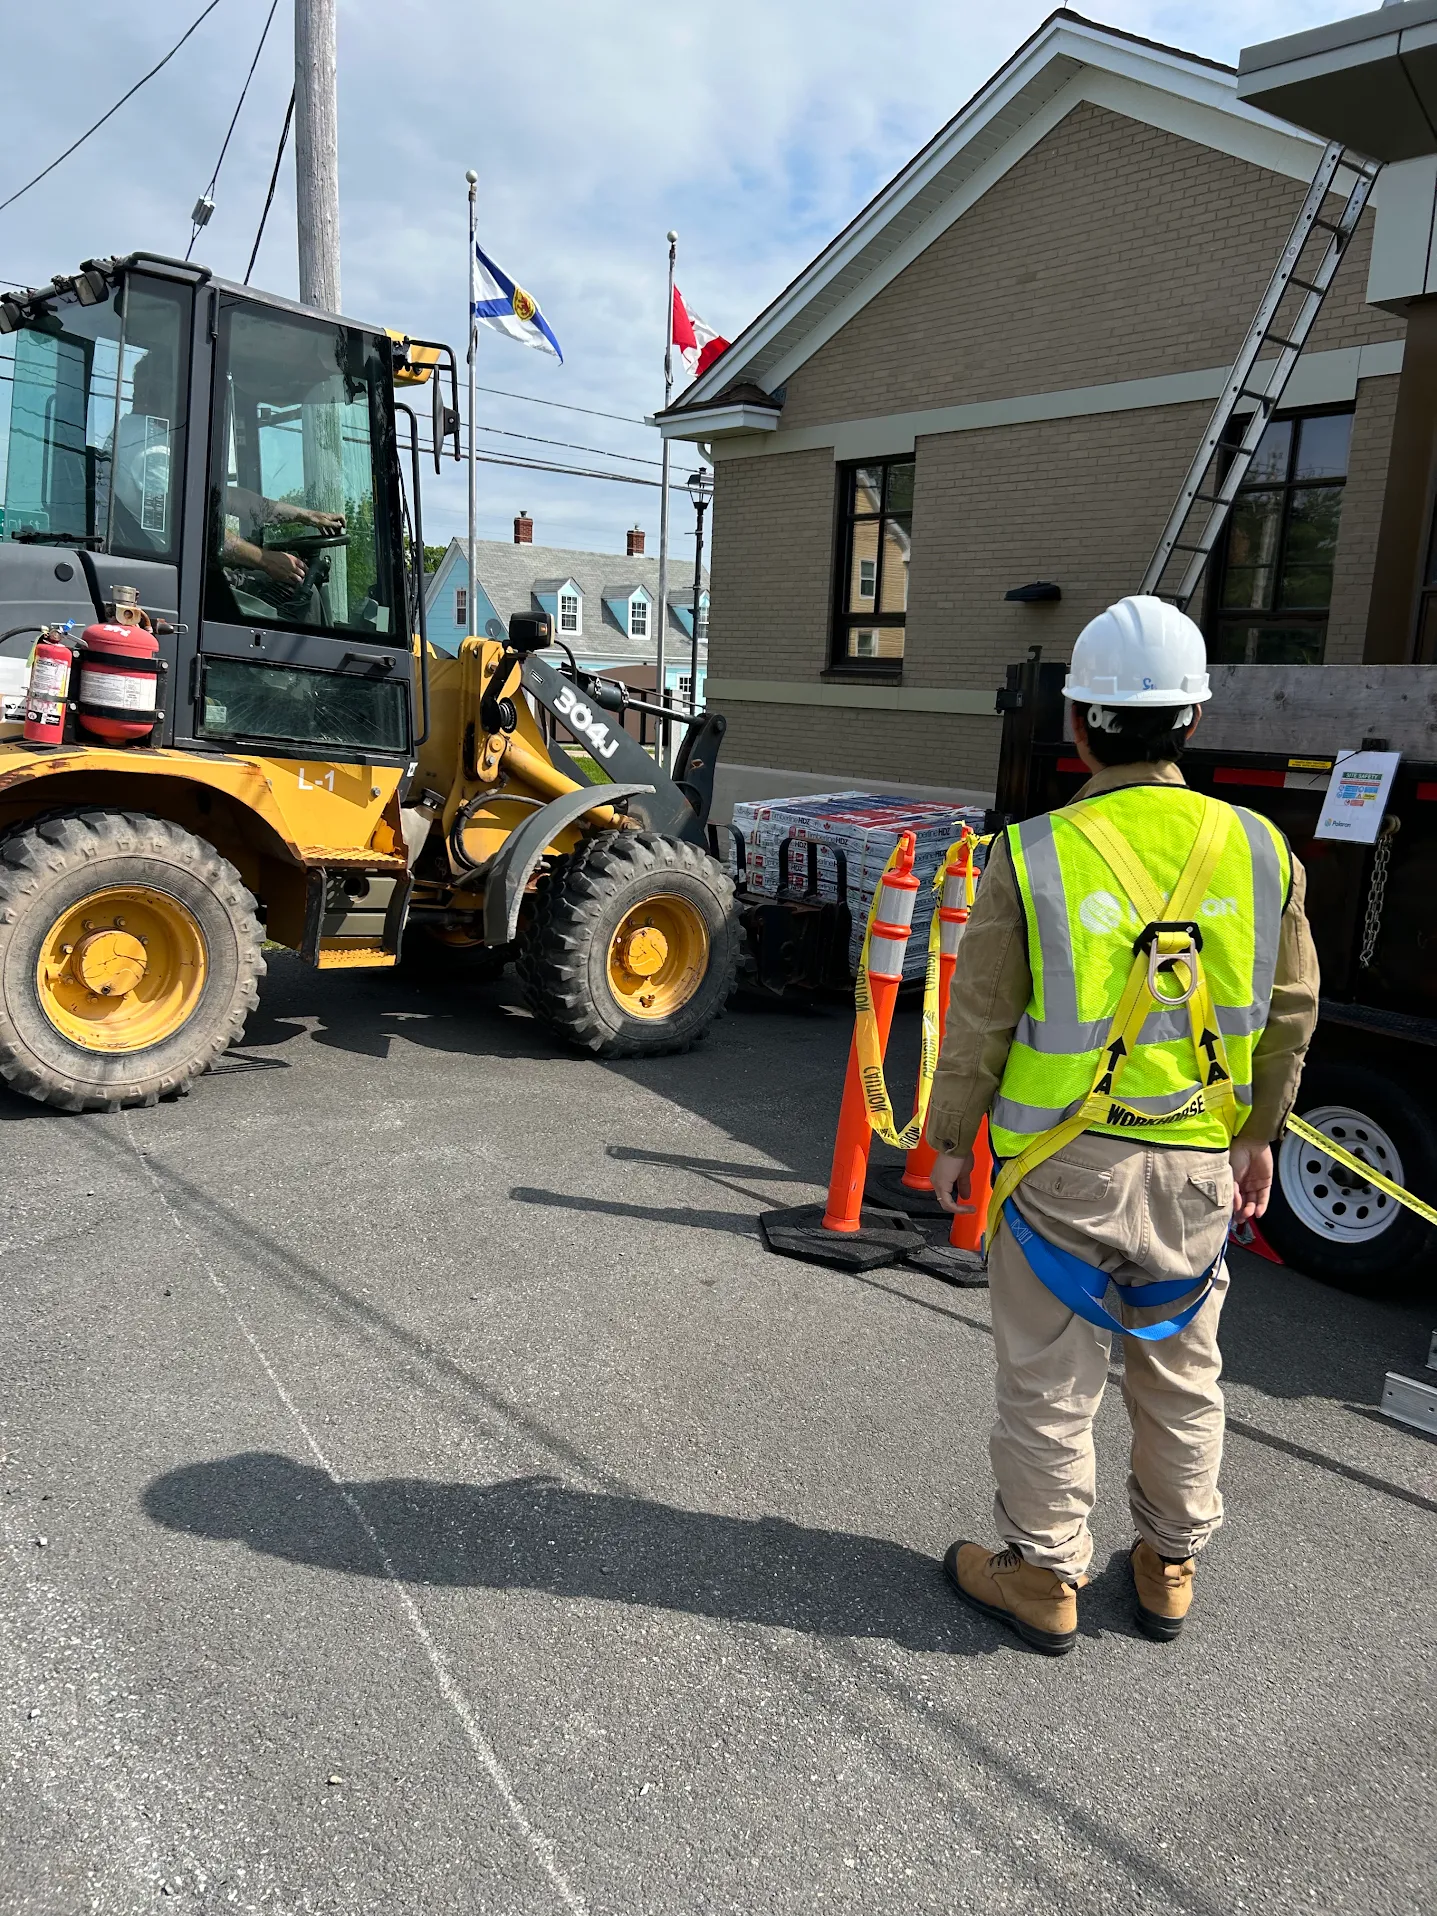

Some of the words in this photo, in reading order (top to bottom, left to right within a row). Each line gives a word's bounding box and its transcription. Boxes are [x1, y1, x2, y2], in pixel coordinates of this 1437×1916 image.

[553, 685, 620, 758] 304J
[298, 767, 335, 792] L-1
[1106, 1095, 1206, 1127] WORKHORSE
